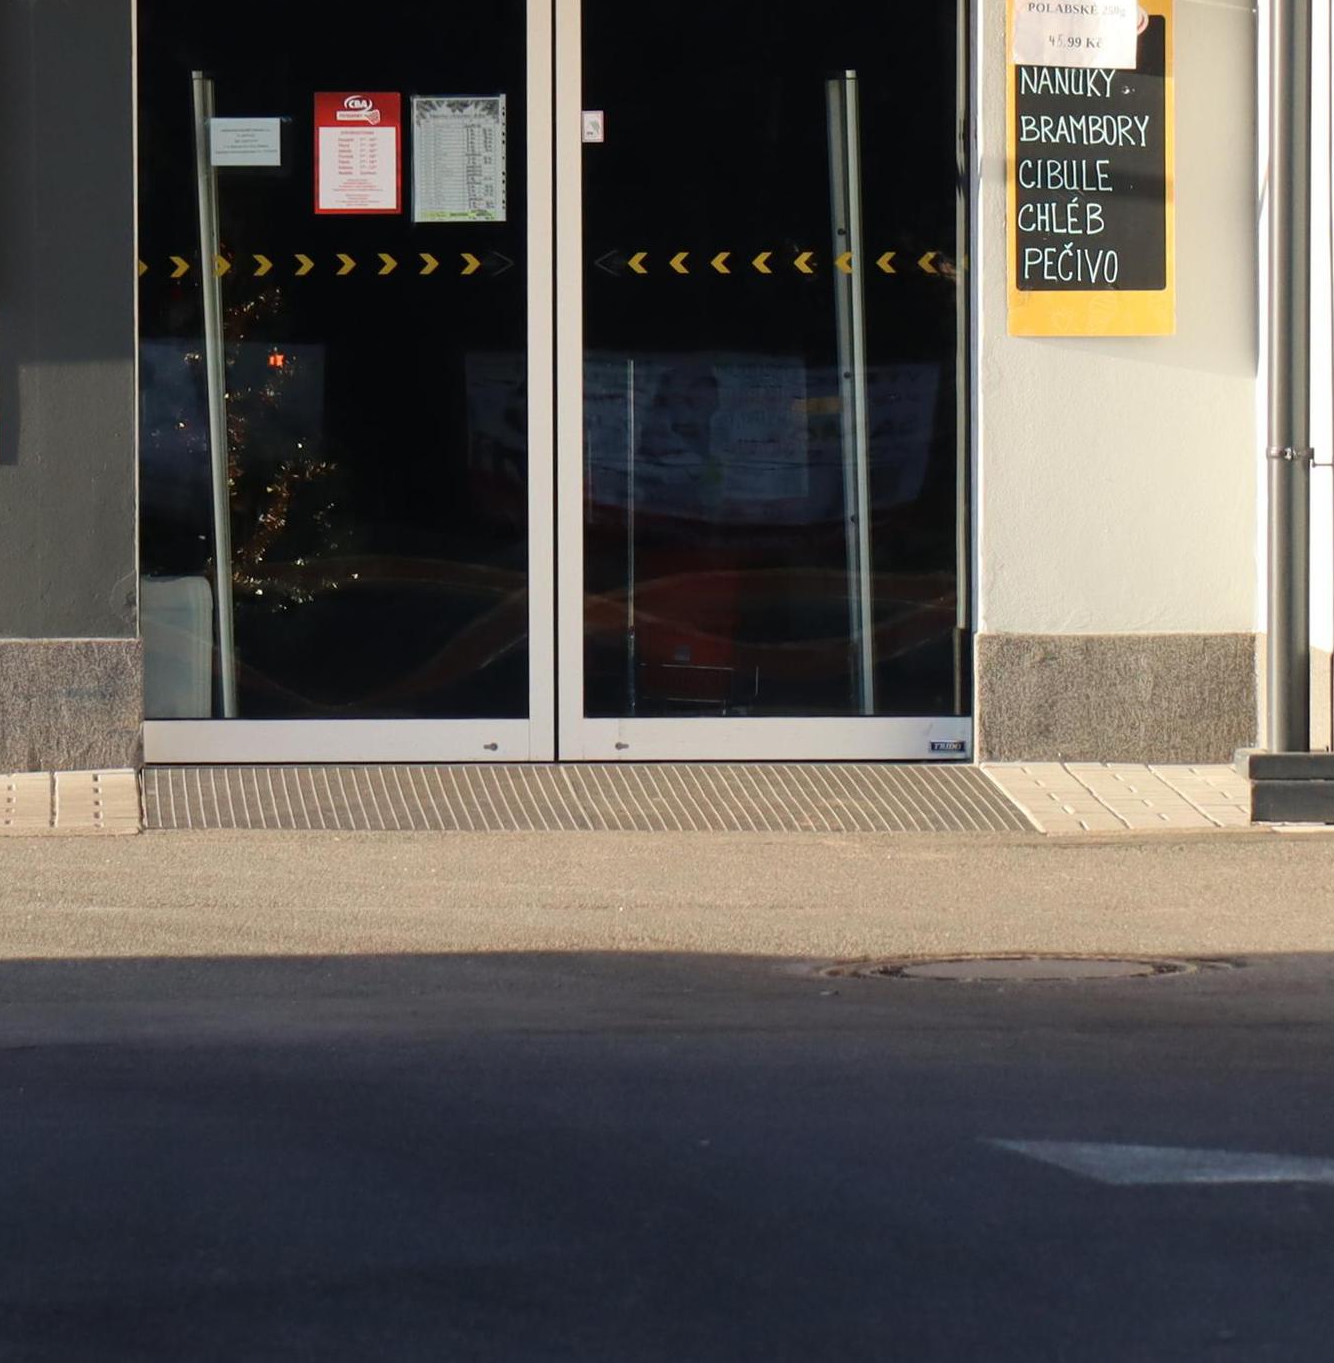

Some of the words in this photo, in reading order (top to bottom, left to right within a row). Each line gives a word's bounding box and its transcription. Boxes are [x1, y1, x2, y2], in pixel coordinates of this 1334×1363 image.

[1020, 66, 1116, 98] NANUKY
[1019, 115, 1150, 147] BRAMBORY
[1018, 159, 1113, 192] CIBULE
[1018, 197, 1105, 236] CHLÉB
[1023, 242, 1119, 284] PEČIVO
